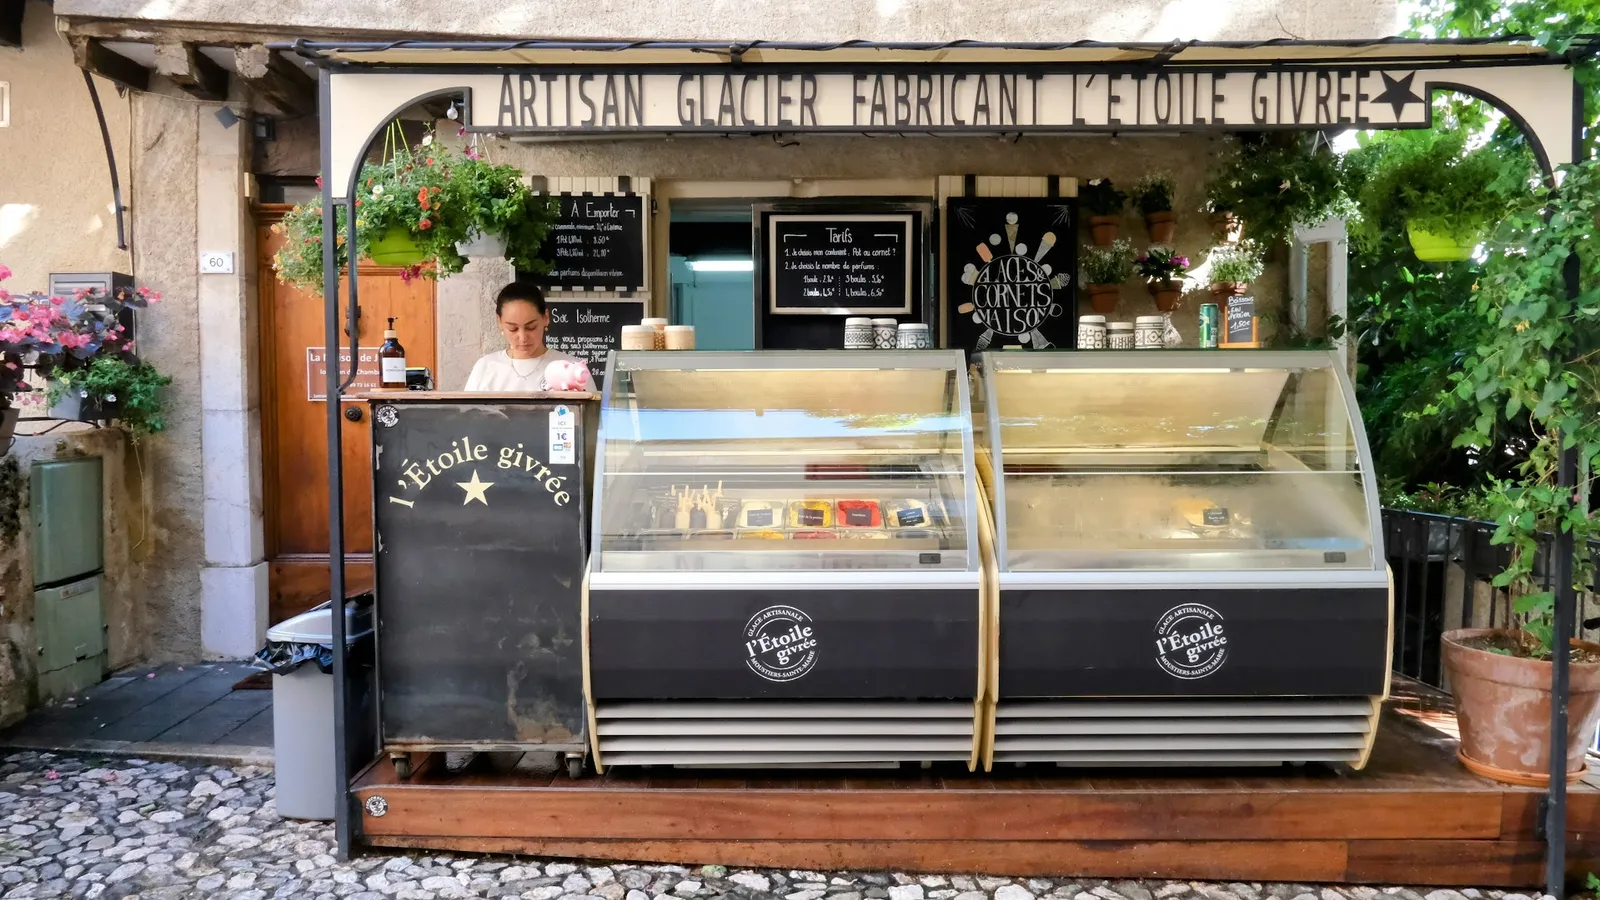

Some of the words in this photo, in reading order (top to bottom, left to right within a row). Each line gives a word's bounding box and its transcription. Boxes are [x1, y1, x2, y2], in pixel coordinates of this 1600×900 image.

[499, 73, 644, 127] ARTISAN
[676, 73, 818, 127] GLACIER
[853, 73, 1044, 127] FABRICANT
[1251, 70, 1371, 125] GIVREE
[586, 202, 620, 221] Emporter
[825, 227, 853, 244] Tarifs
[209, 257, 224, 267] 60
[852, 247, 862, 257] Pot
[871, 247, 891, 257] cornet
[842, 260, 850, 270] de
[852, 261, 875, 273] parfums
[974, 283, 1051, 308] CORNETS
[551, 308, 569, 323] Sac
[576, 309, 610, 323] Isotherme
[978, 307, 1047, 334] MAISON
[545, 335, 559, 343] Nous
[578, 336, 603, 345] proposons
[310, 353, 320, 362] La
[360, 353, 372, 362] de
[556, 432, 568, 440] 1€
[389, 436, 489, 509] l'Étoile
[497, 443, 570, 507] givrée
[748, 617, 763, 637] GLACE
[763, 609, 804, 622] ARTISANALE
[1158, 614, 1175, 635] GLACE
[1174, 607, 1215, 620] ARTISANALE
[745, 624, 813, 658] l'Étoile
[776, 637, 817, 665] givrée
[1155, 622, 1224, 656] l'Étoile
[1186, 635, 1228, 663] givrée
